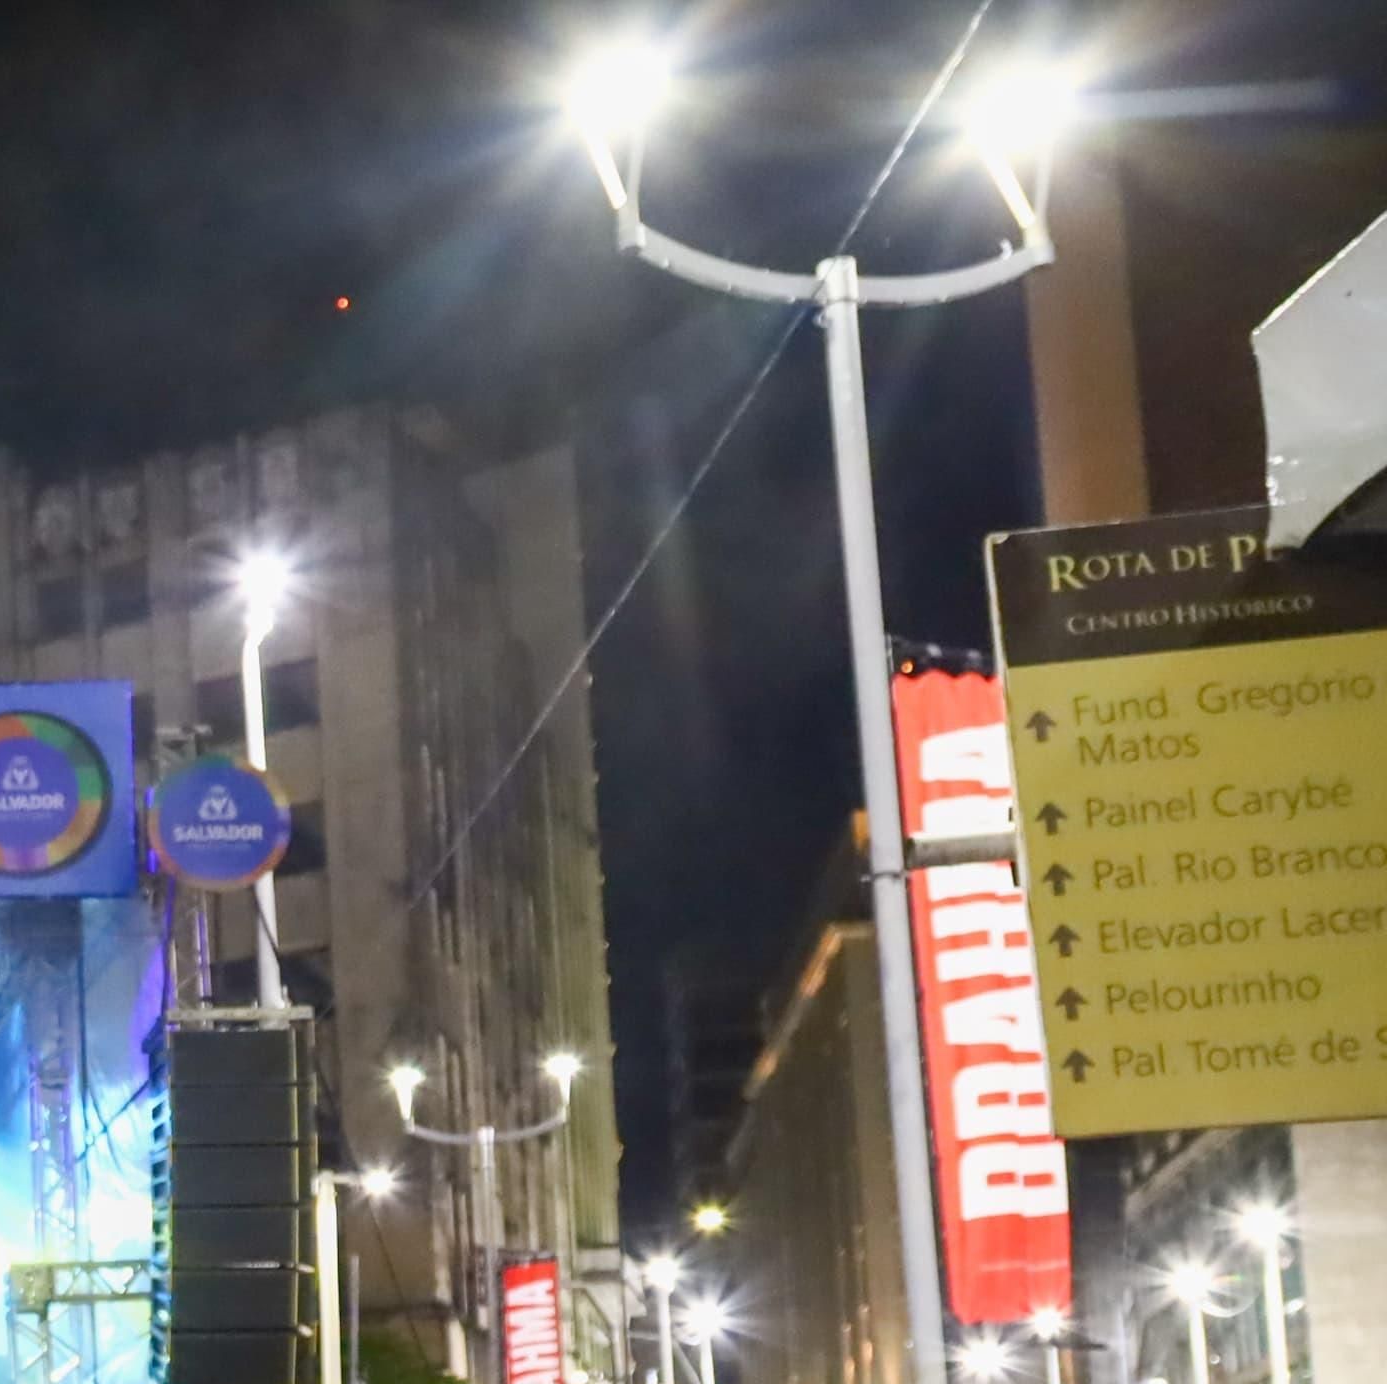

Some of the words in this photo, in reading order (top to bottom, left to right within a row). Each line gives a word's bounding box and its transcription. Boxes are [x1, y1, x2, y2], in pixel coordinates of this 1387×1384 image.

[1047, 552, 1155, 592] ROTA
[1170, 544, 1214, 572] DE
[1067, 607, 1170, 635] CENTRO
[1196, 674, 1375, 716] Gregório
[1077, 731, 1201, 767] Matos
[1085, 787, 1198, 829] Painel
[1210, 776, 1354, 821] Carybé
[172, 824, 264, 842] SALVADOR
[1174, 849, 1238, 884] Rio
[1250, 841, 1387, 879] Branco
[1098, 910, 1266, 954] Elevador
[1106, 969, 1323, 1015] Pelourinho
[1187, 1034, 1296, 1073] Tomé
[1310, 1029, 1362, 1065] de
